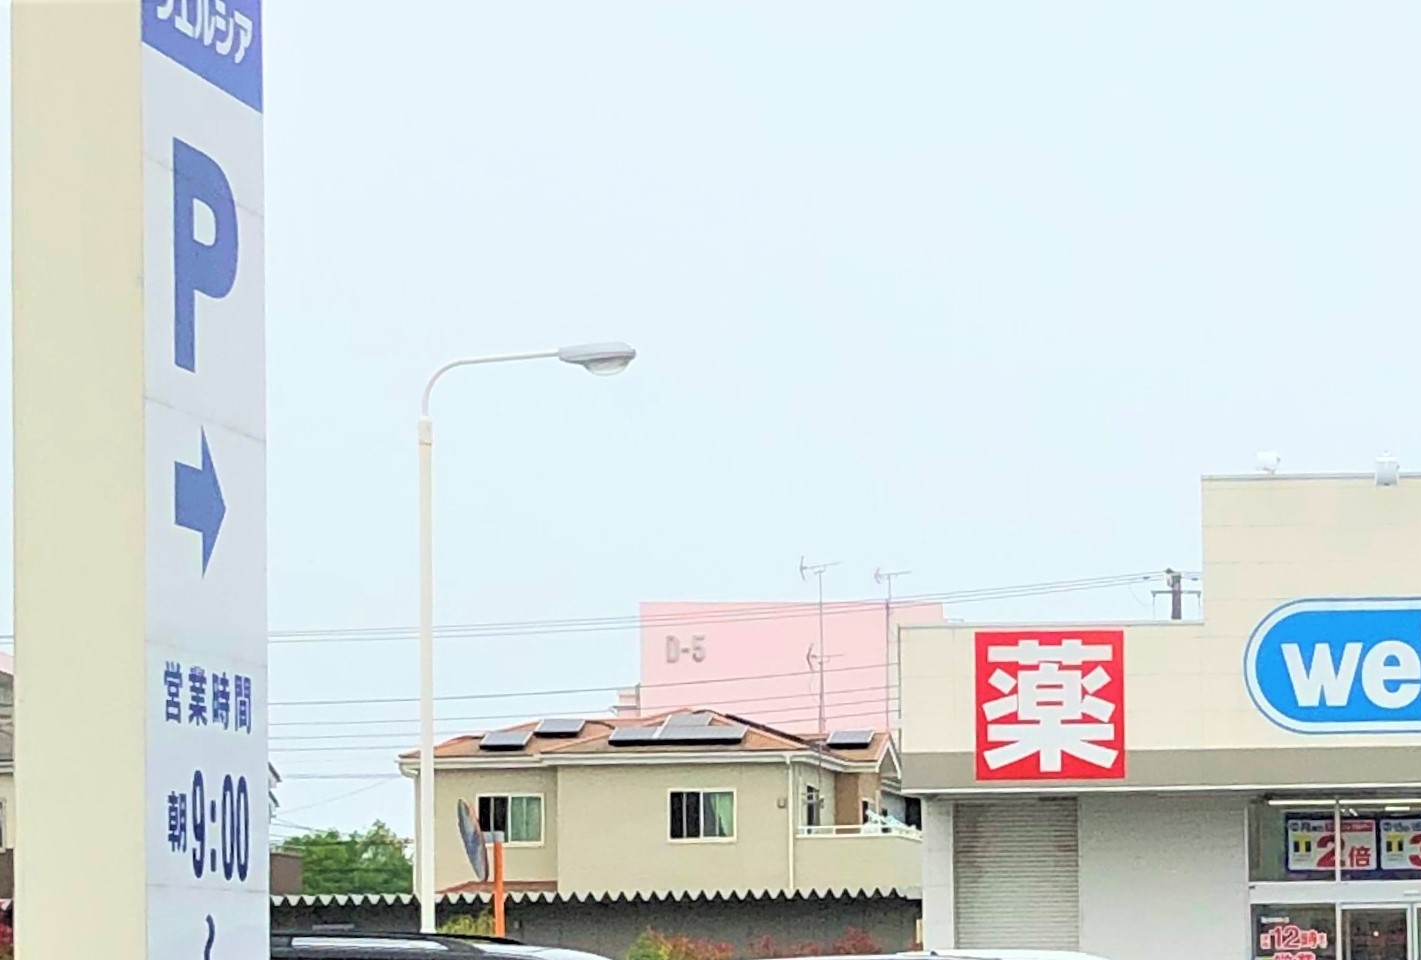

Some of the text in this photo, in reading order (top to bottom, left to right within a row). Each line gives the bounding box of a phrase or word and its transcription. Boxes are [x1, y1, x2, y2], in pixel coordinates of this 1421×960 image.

[172, 136, 240, 374] P
[164, 660, 252, 735] 営業時間
[665, 634, 706, 664] D-5
[983, 638, 1117, 773] 薬
